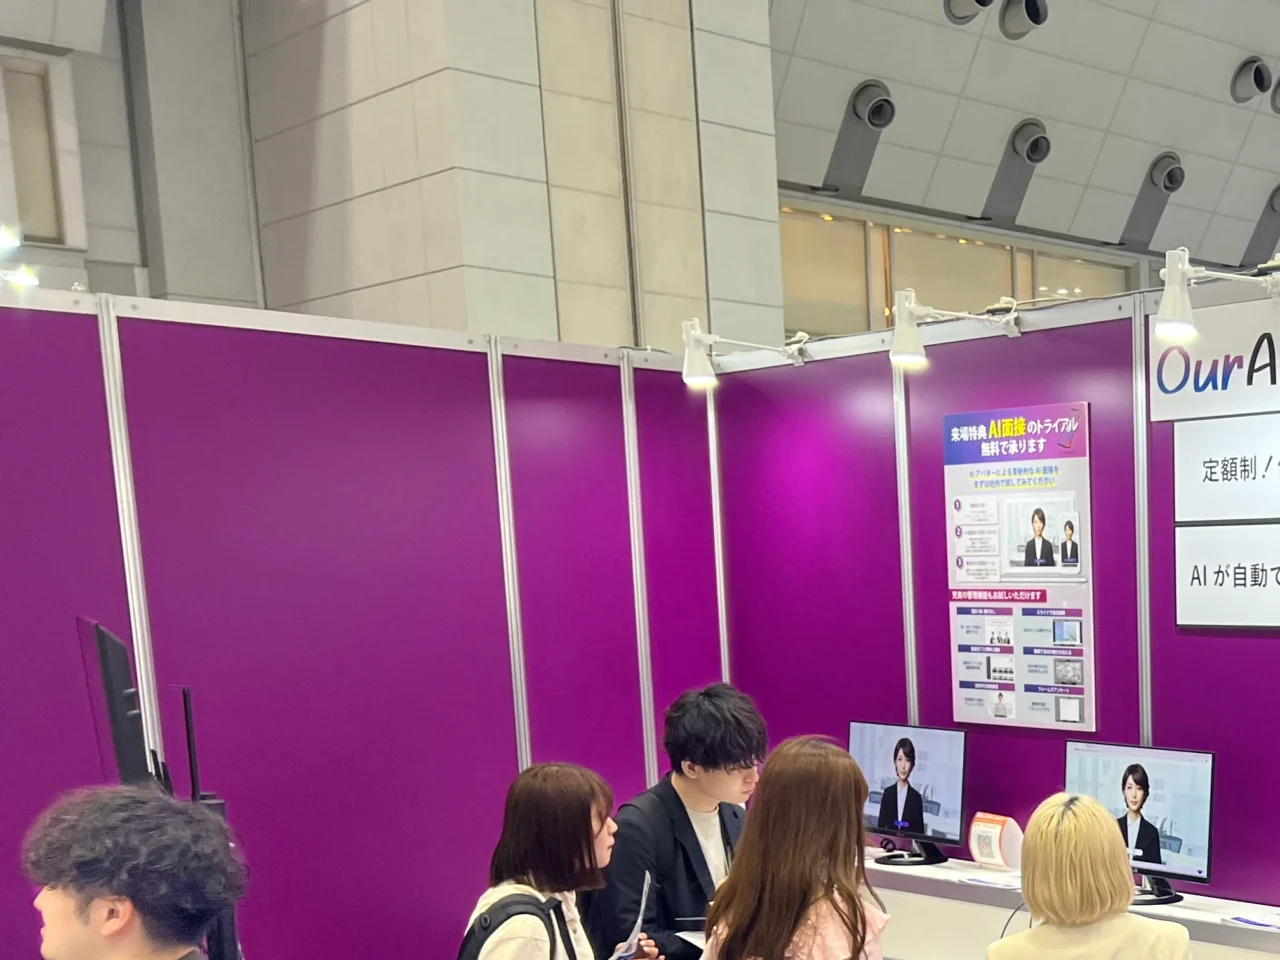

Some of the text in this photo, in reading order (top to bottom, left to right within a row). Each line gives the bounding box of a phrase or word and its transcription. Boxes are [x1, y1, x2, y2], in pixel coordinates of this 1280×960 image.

[981, 437, 1046, 457] 無料で承ります
